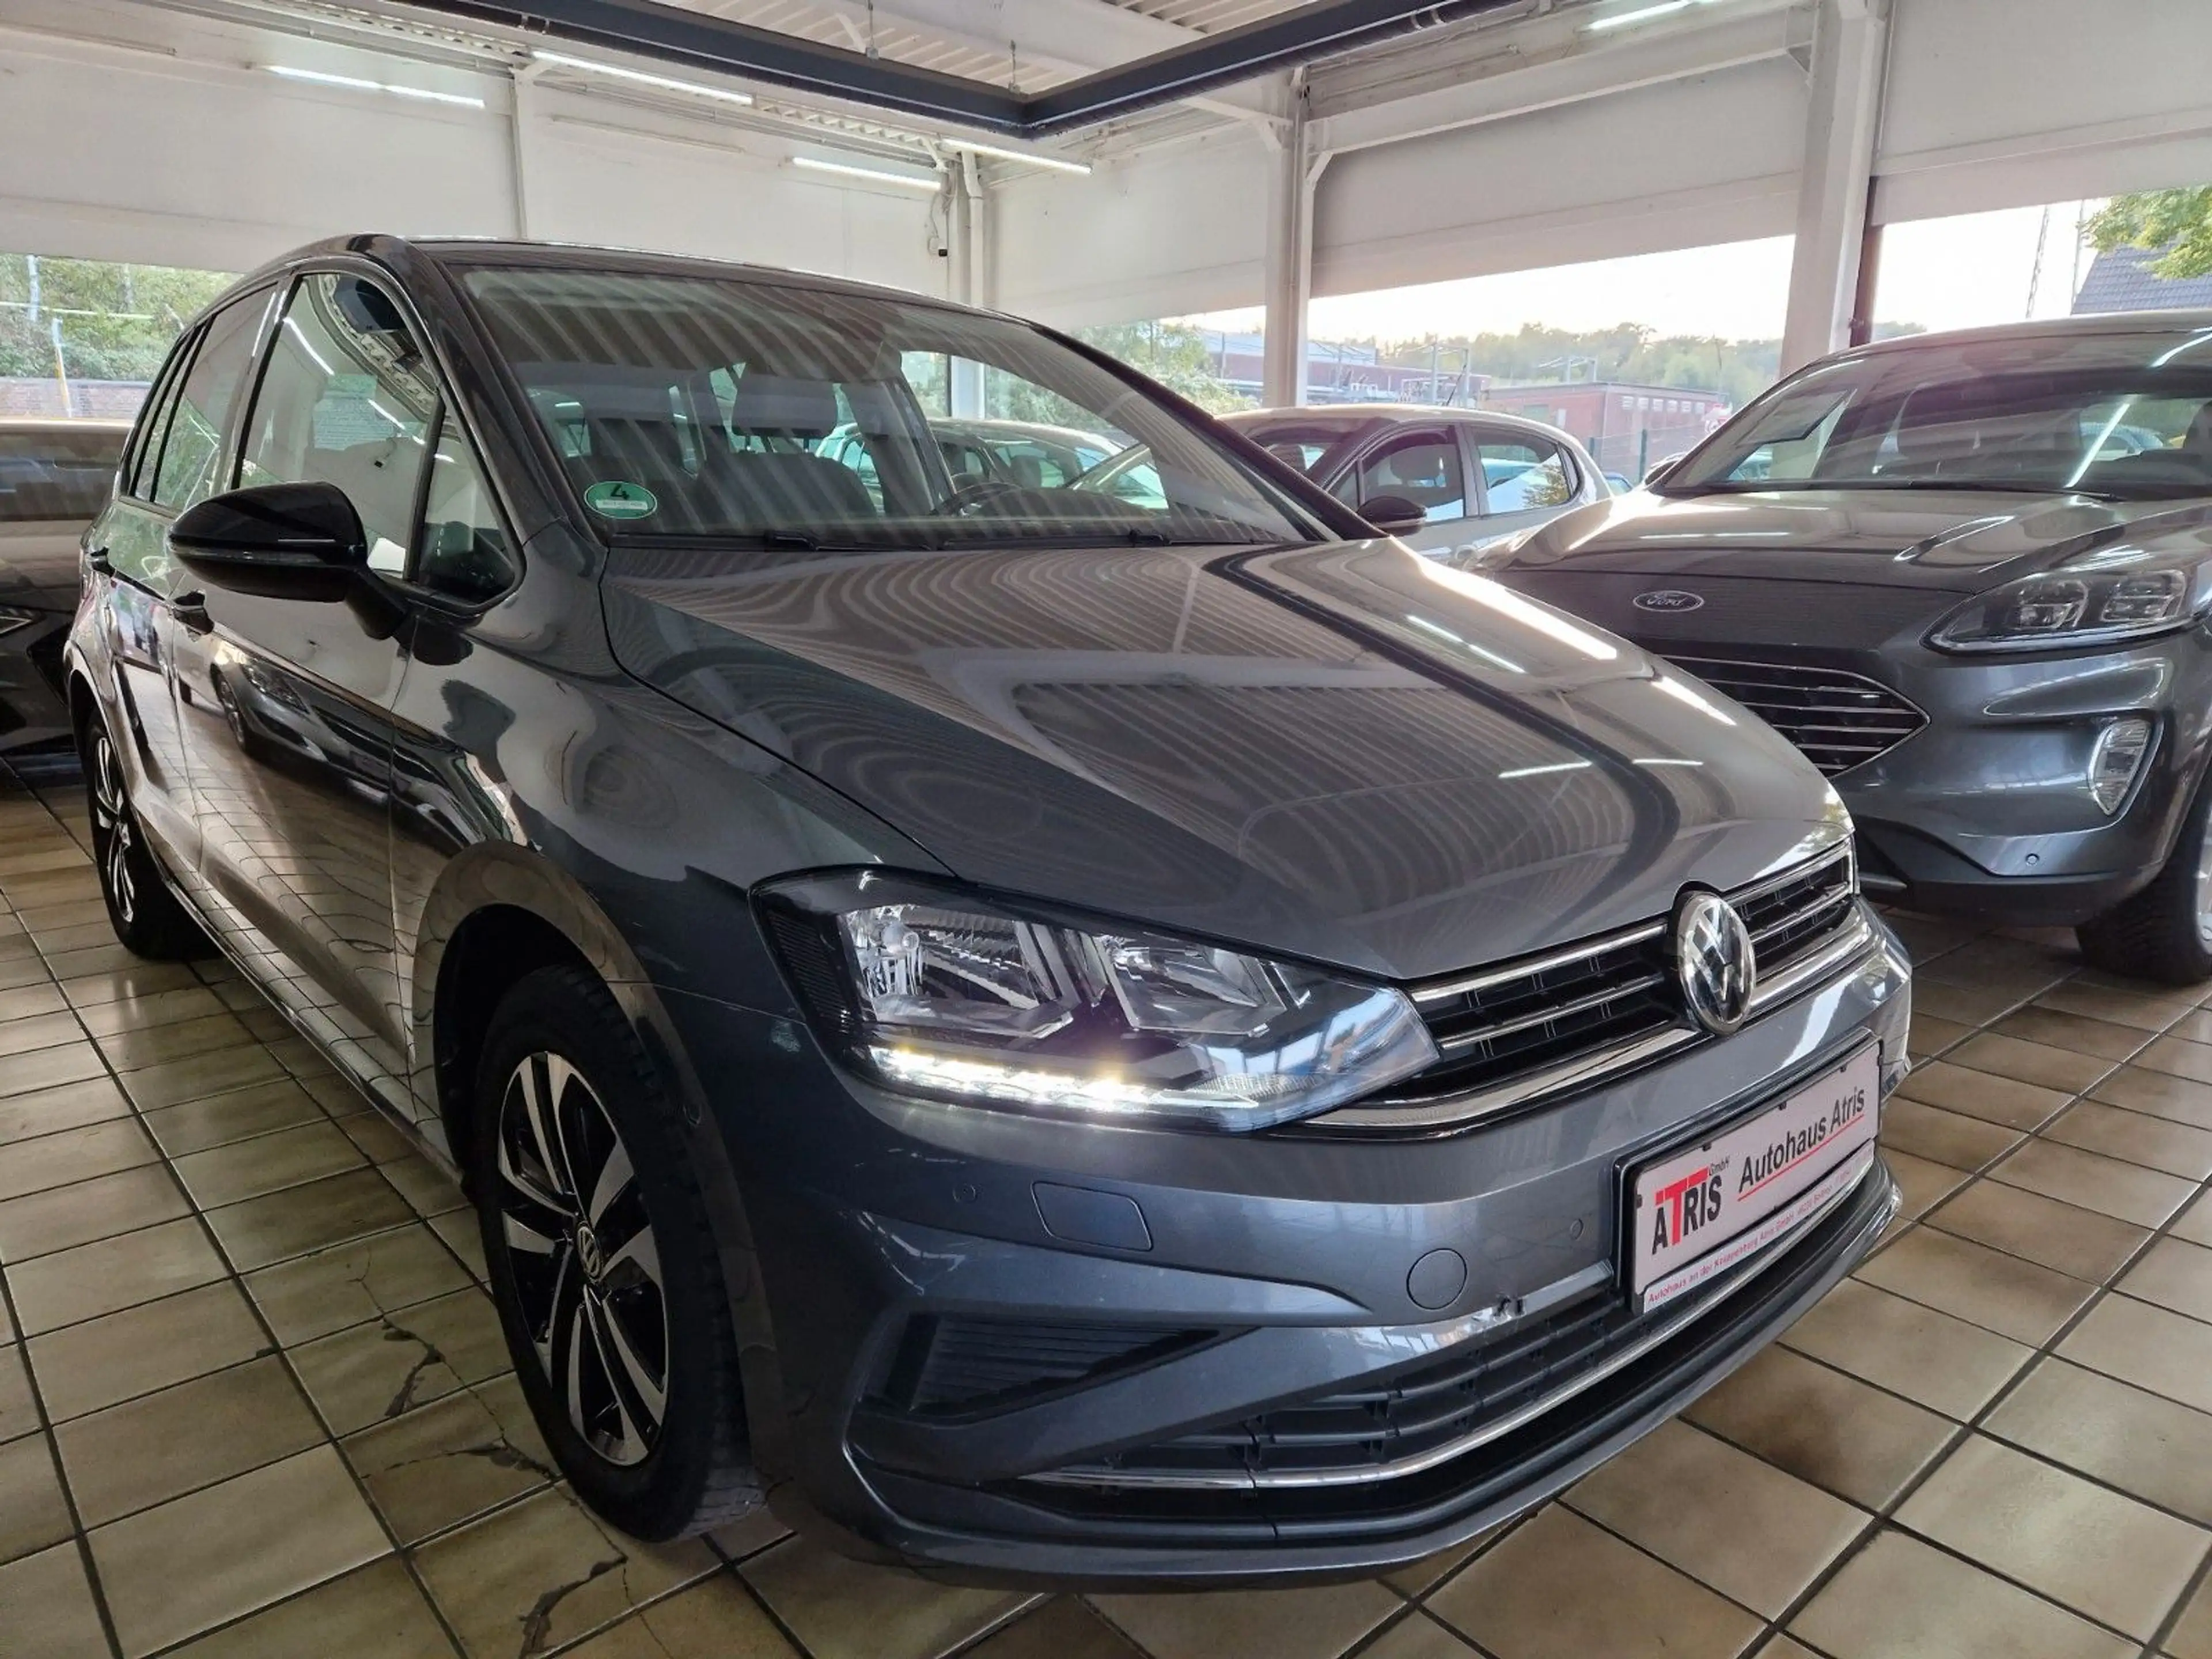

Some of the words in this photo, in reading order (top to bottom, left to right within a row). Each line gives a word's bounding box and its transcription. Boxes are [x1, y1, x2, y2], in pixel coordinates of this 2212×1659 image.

[611, 484, 630, 500] 4
[1647, 593, 1689, 606] Ford
[1738, 1116, 1827, 1194] Autohaus
[1830, 1086, 1865, 1133] Atris
[1652, 1166, 1722, 1255] ATRIS
